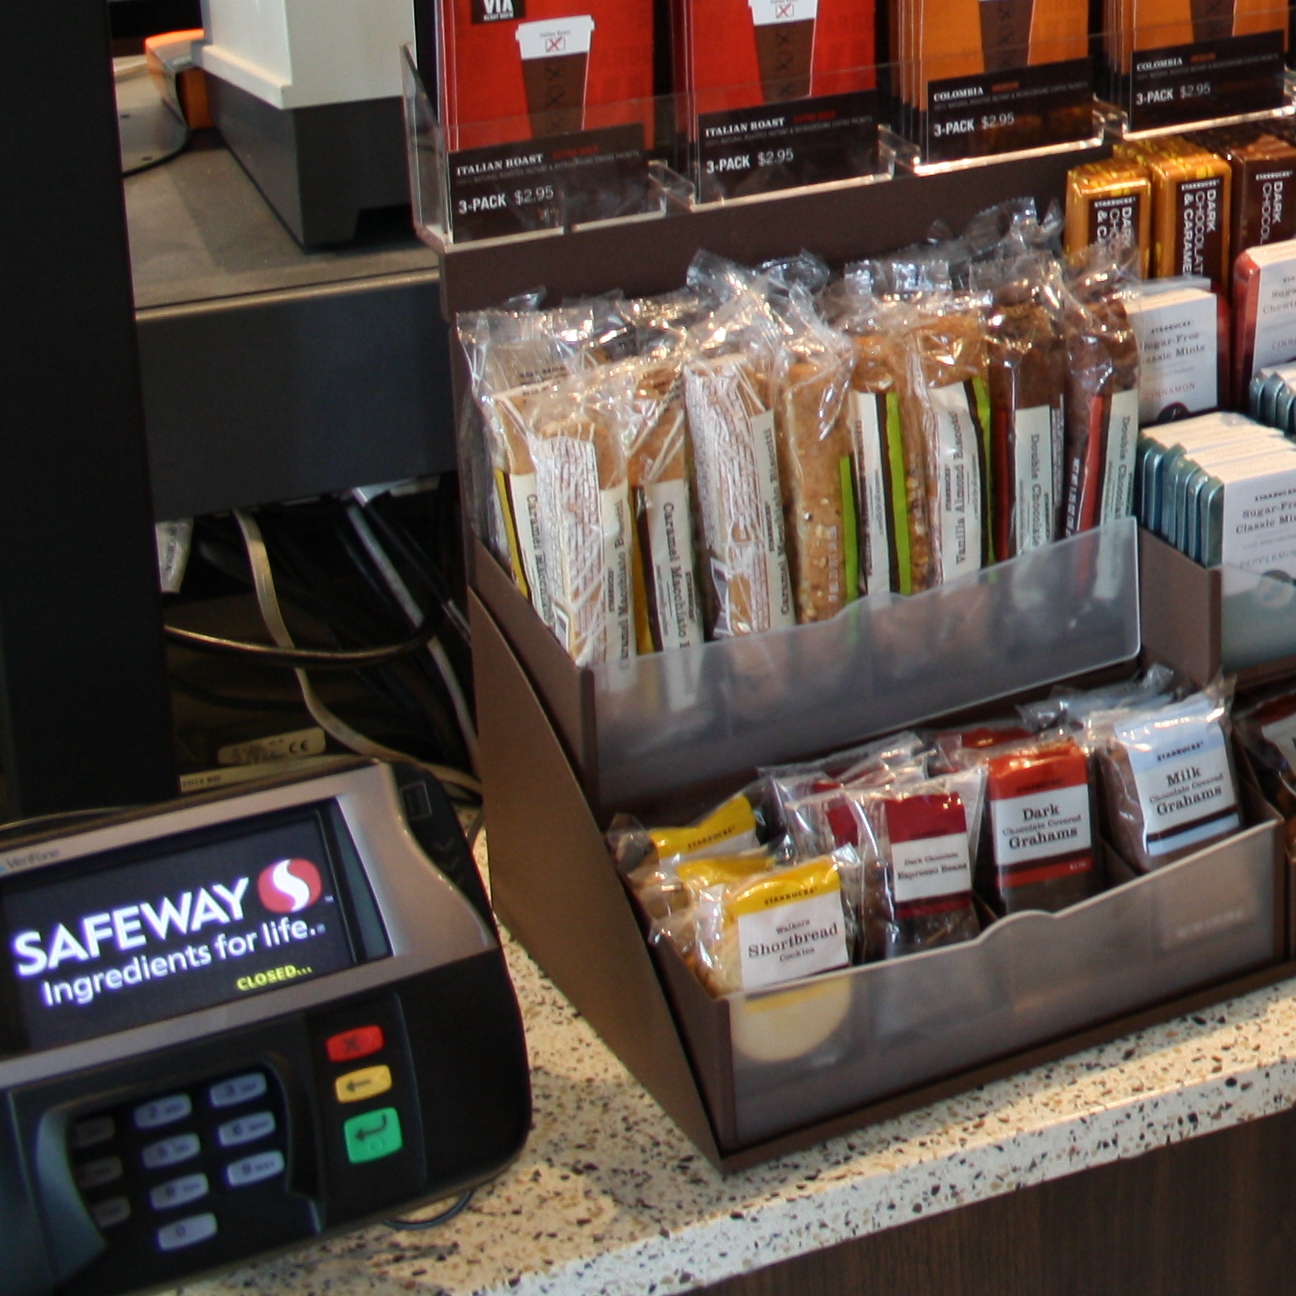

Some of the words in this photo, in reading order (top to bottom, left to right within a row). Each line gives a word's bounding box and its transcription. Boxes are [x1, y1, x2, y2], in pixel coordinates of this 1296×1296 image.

[1136, 57, 1184, 72] COLOMBIA
[933, 85, 984, 102] COLOMBIA
[1136, 87, 1175, 106] 3-PACK
[1180, 82, 1211, 100] $2.95
[705, 122, 747, 138] ITALIAN
[750, 116, 786, 131] ROAST
[933, 118, 976, 138] 3-PACK
[456, 160, 503, 177] ITALIAN
[505, 154, 544, 168] ROAST
[1183, 193, 1194, 206] &
[1206, 190, 1217, 233] DARK
[1272, 181, 1284, 224] DARK
[1175, 343, 1206, 359] Mints
[1119, 415, 1131, 461] Double
[1030, 433, 1041, 480] Double
[953, 462, 965, 513] Almond
[955, 516, 967, 564] Vanilla
[1166, 766, 1203, 788] Milk
[1191, 772, 1225, 790] Covered
[1021, 803, 1061, 822] Dark
[1156, 786, 1223, 816] Grahams
[1047, 813, 1082, 829] Covered
[1008, 826, 1079, 851] Grahams
[13, 876, 251, 977] SAFEWAY
[747, 922, 839, 958] Shortbread
[41, 945, 212, 1007] Ingredients
[214, 930, 259, 960] for
[263, 916, 318, 947] life.
